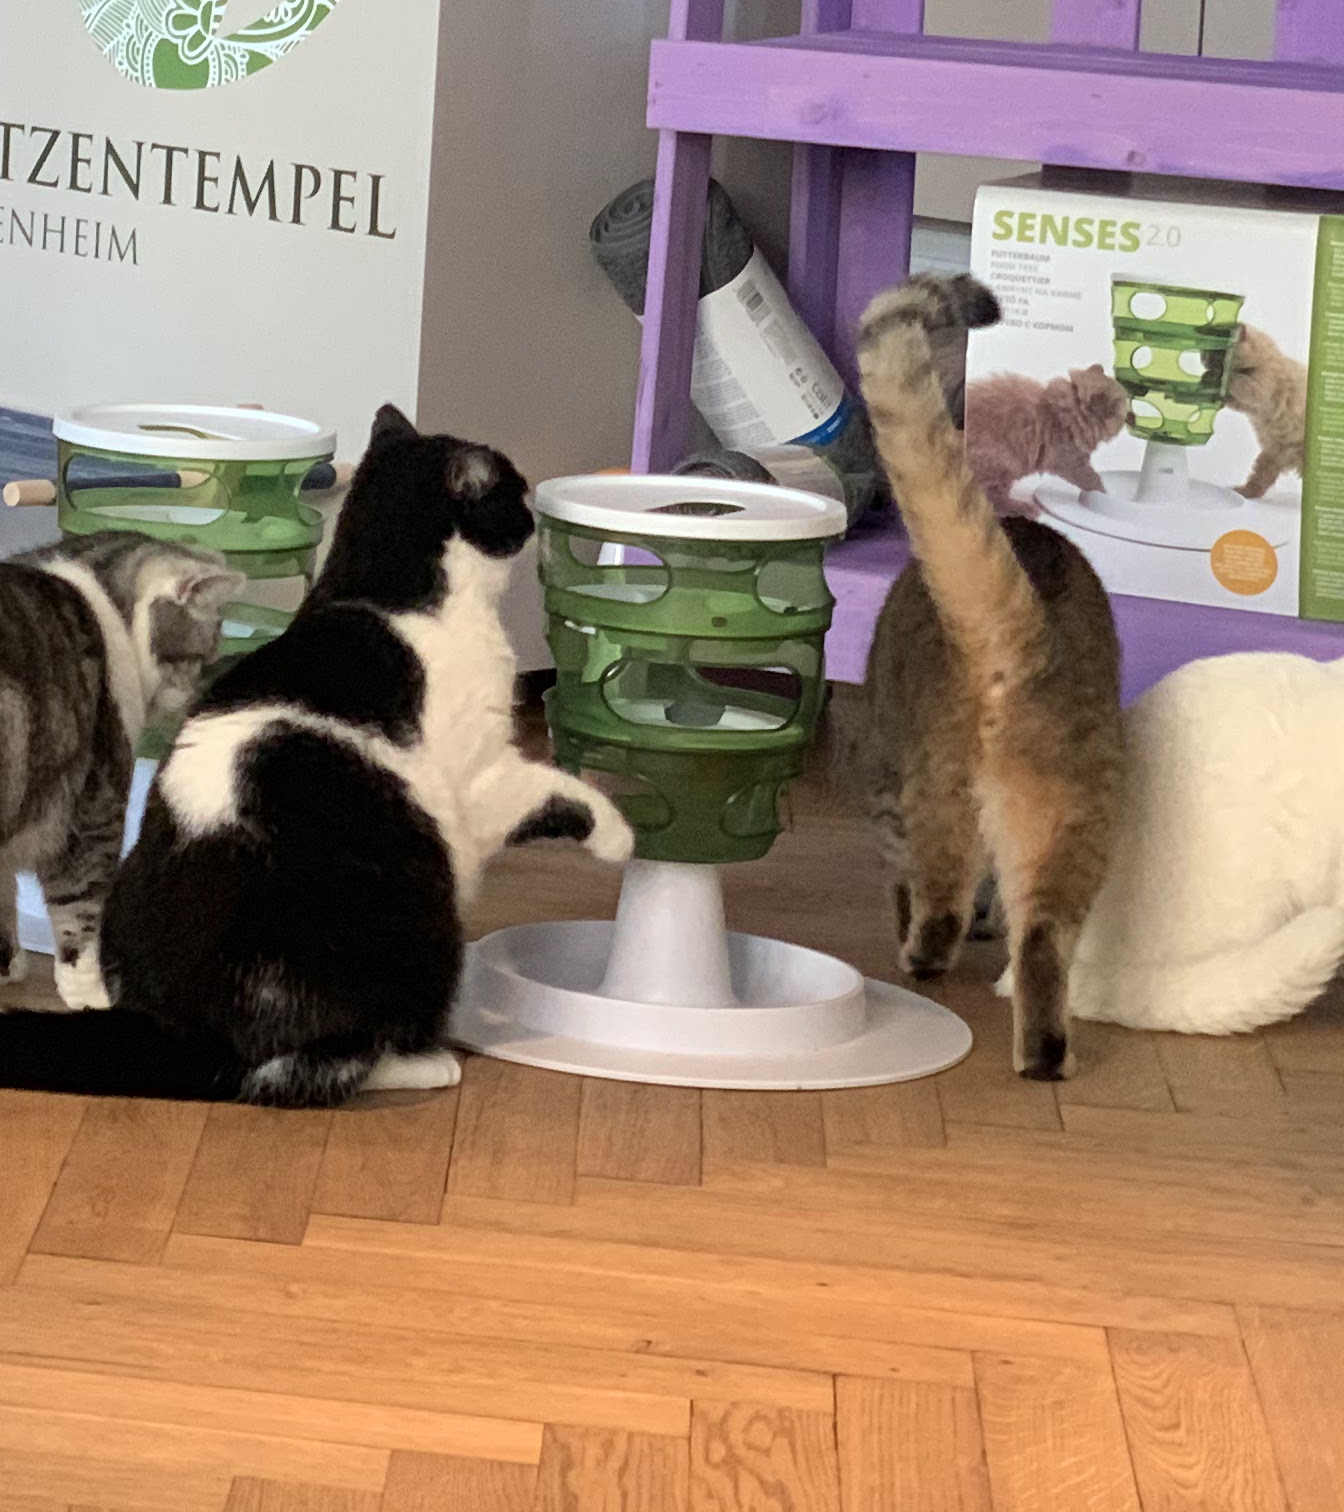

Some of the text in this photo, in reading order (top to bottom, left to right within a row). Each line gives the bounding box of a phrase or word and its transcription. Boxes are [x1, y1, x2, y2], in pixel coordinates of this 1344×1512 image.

[991, 209, 1182, 253] SENSES 2.0
[990, 249, 1051, 263] FUTTERBAUM
